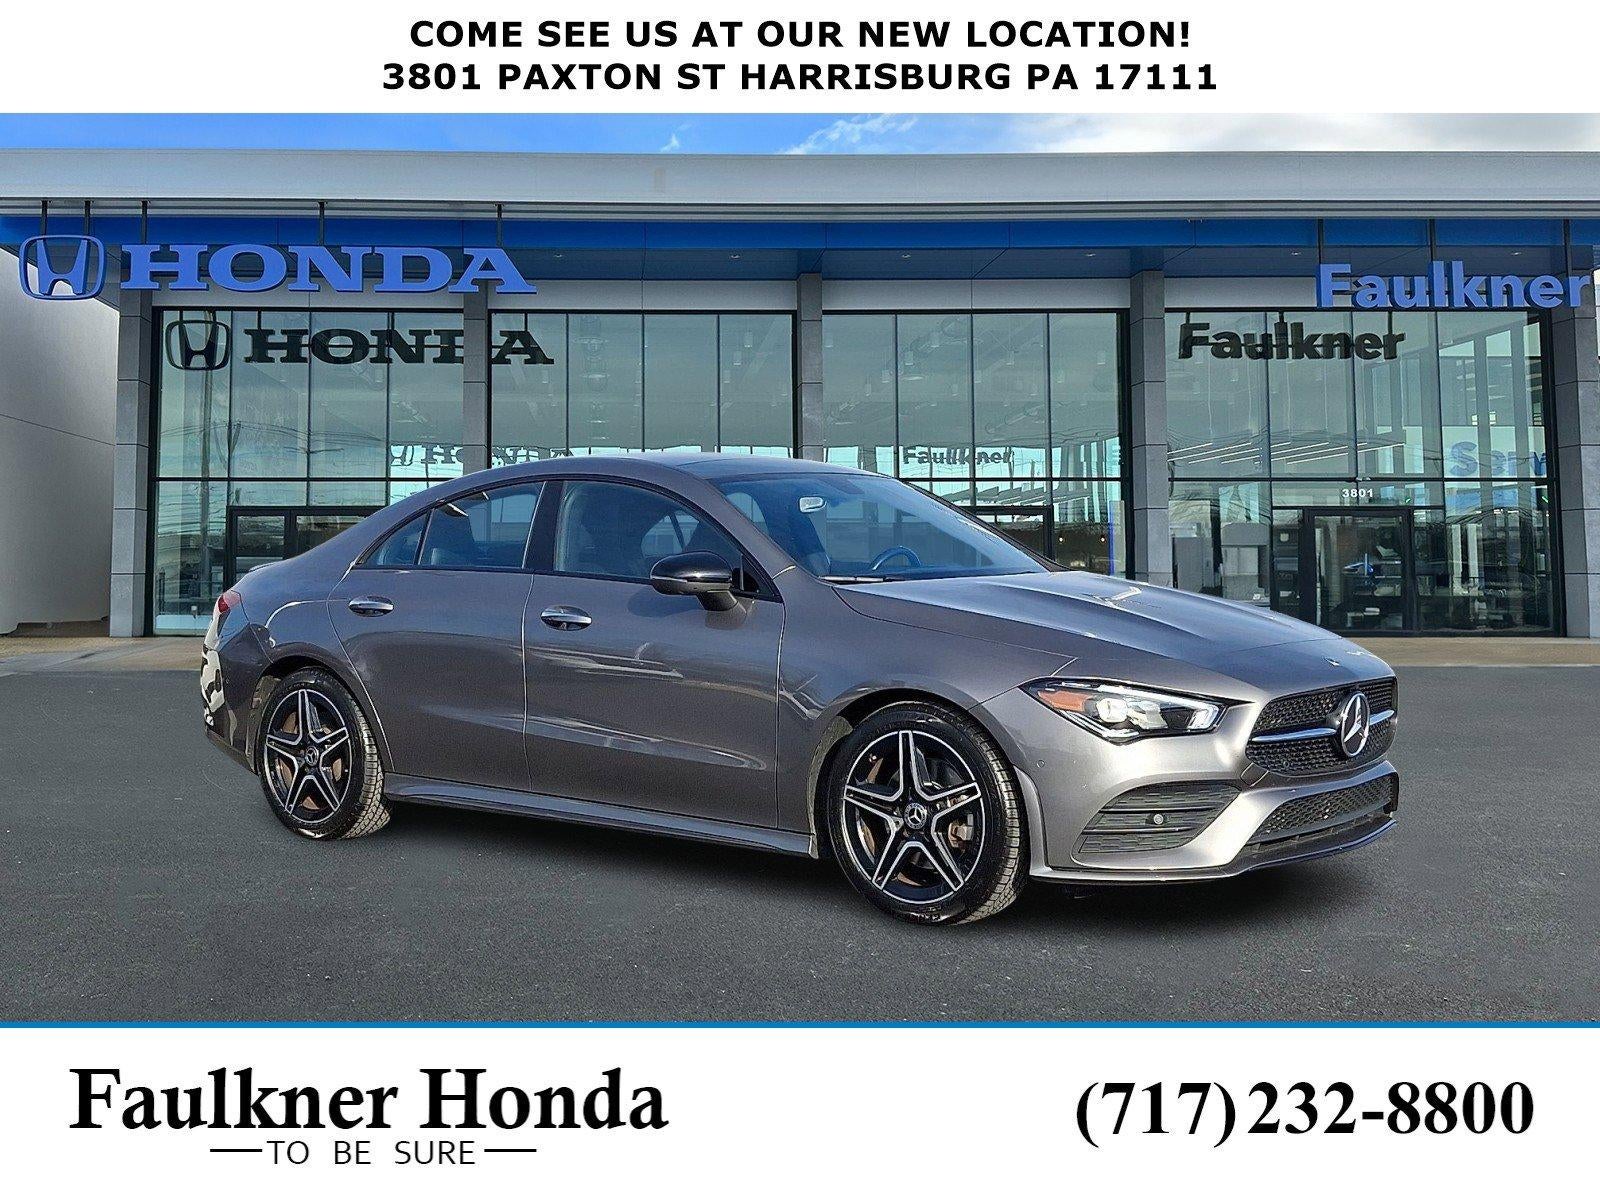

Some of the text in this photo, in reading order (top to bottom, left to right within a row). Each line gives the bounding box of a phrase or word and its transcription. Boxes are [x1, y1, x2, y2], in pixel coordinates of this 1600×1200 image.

[121, 244, 537, 295] HONDA
[1316, 260, 1591, 309] Faulkner
[1178, 321, 1405, 360] Faulkner
[1341, 488, 1373, 498] 3801
